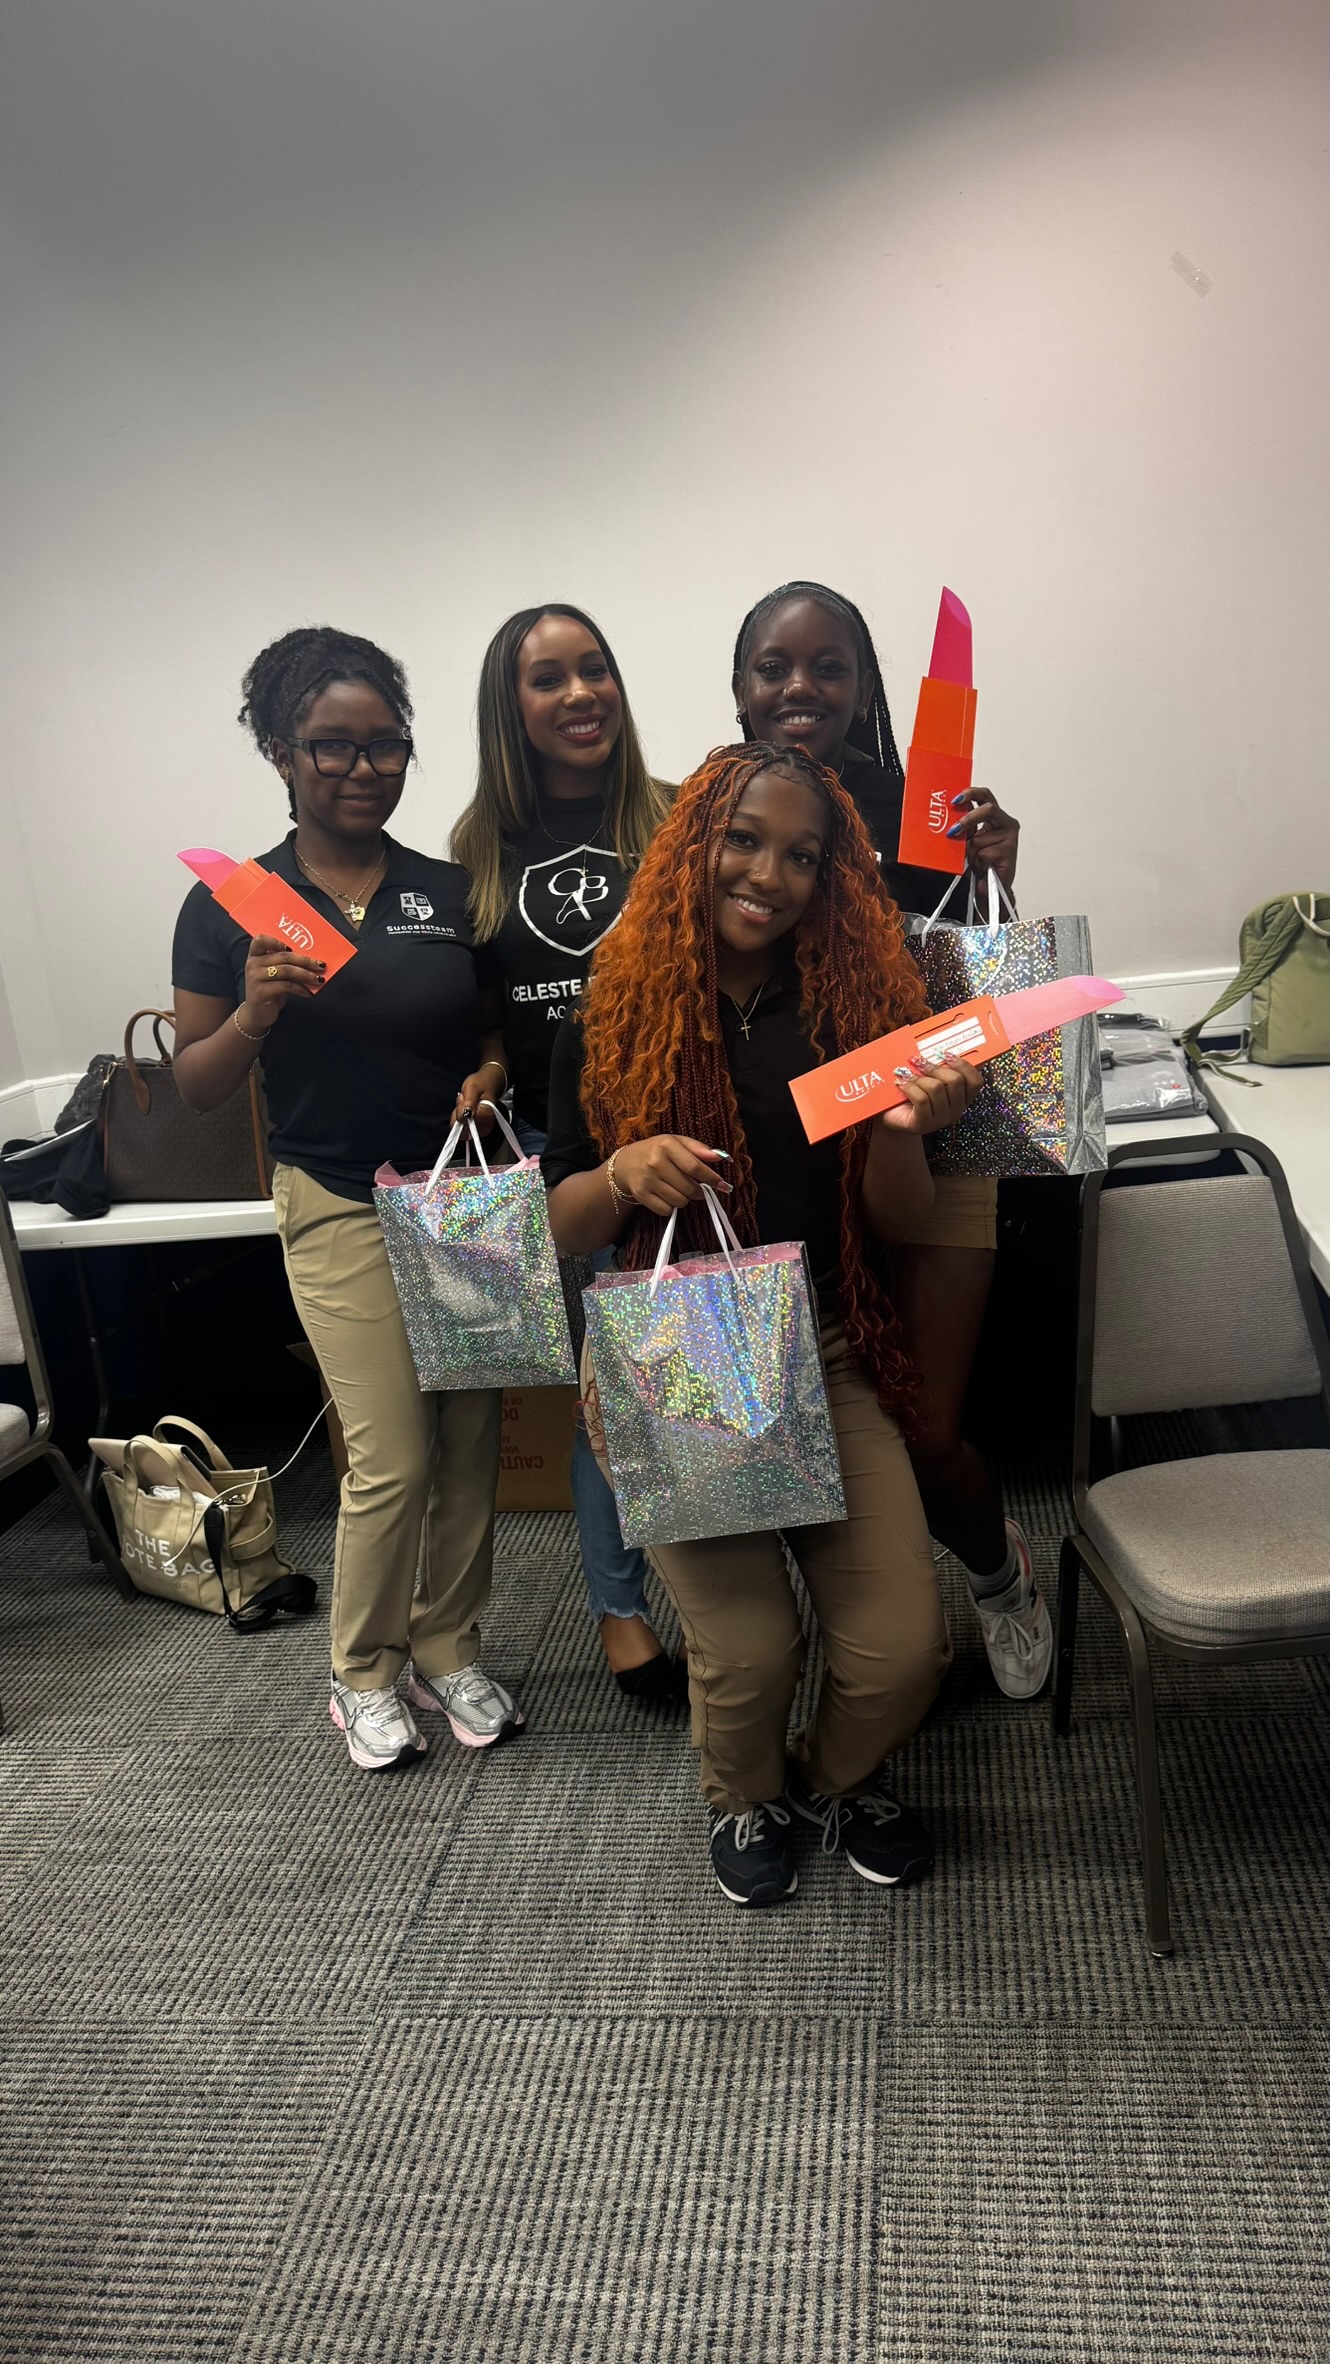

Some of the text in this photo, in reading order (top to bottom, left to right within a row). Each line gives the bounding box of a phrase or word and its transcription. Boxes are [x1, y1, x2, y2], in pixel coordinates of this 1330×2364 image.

[928, 790, 948, 833] ULTA
[278, 914, 313, 950] ULTA
[512, 979, 583, 1002] CELESTE
[836, 1071, 882, 1101] ULTA
[501, 1455, 544, 1470] CAUTI
[135, 1529, 170, 1557] THE
[161, 1559, 215, 1577] BAG
